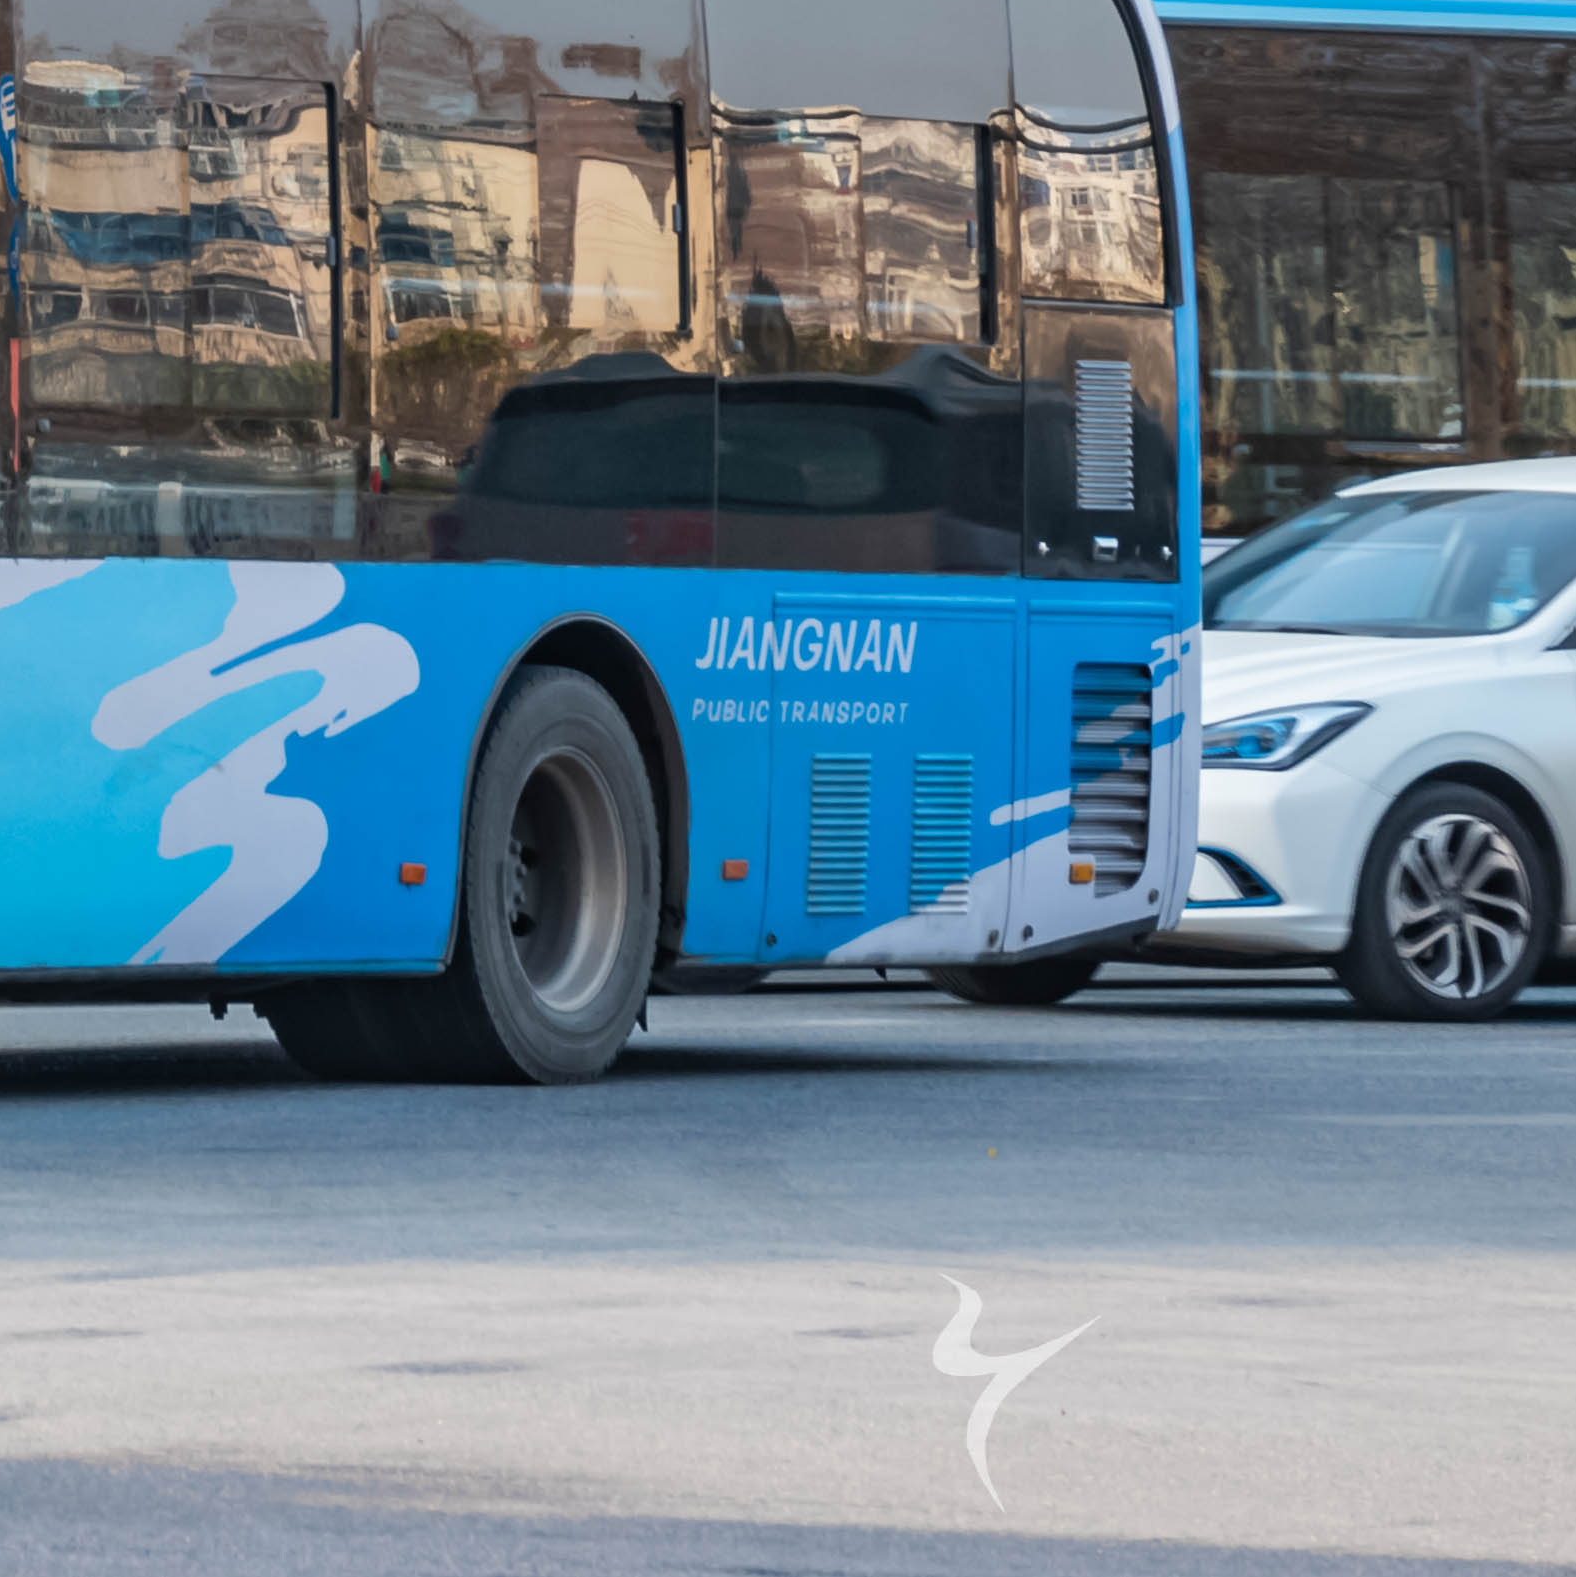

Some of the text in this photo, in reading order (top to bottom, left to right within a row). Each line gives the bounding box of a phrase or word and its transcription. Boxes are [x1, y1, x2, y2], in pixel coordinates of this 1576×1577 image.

[695, 616, 917, 673] JIANGNAN
[692, 699, 909, 724] PUBLIC TRANSPORT
